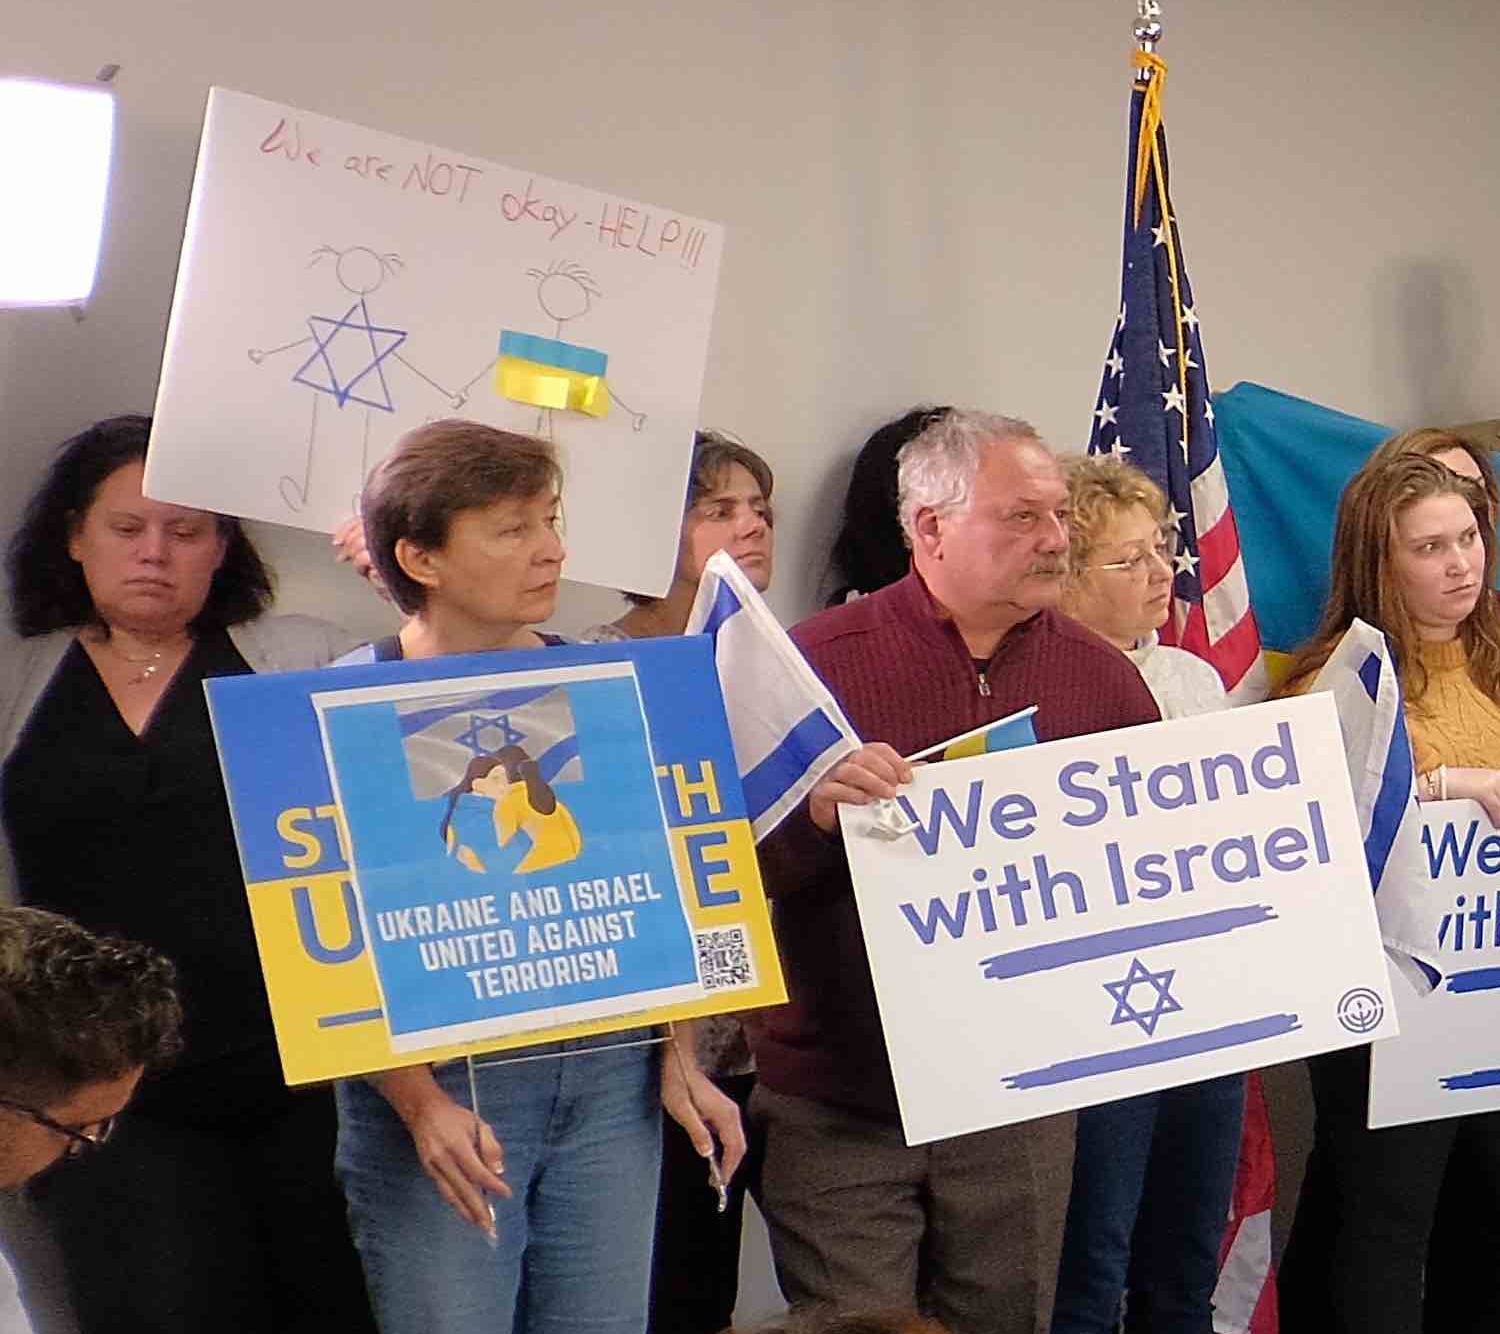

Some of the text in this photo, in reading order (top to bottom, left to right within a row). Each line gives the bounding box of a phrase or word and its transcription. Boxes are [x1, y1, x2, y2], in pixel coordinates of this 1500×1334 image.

[260, 119, 320, 166] We
[344, 155, 394, 181] are
[402, 153, 483, 202] NOT
[501, 179, 578, 240] okay
[895, 721, 1301, 857] We Stand
[376, 894, 498, 943] UKRAINE
[508, 882, 562, 920] AND
[567, 871, 662, 910] ISRAEL
[900, 800, 1331, 946] with Israel
[420, 909, 638, 973] UNITED AGAINST
[465, 949, 619, 1000] TERRORISM
